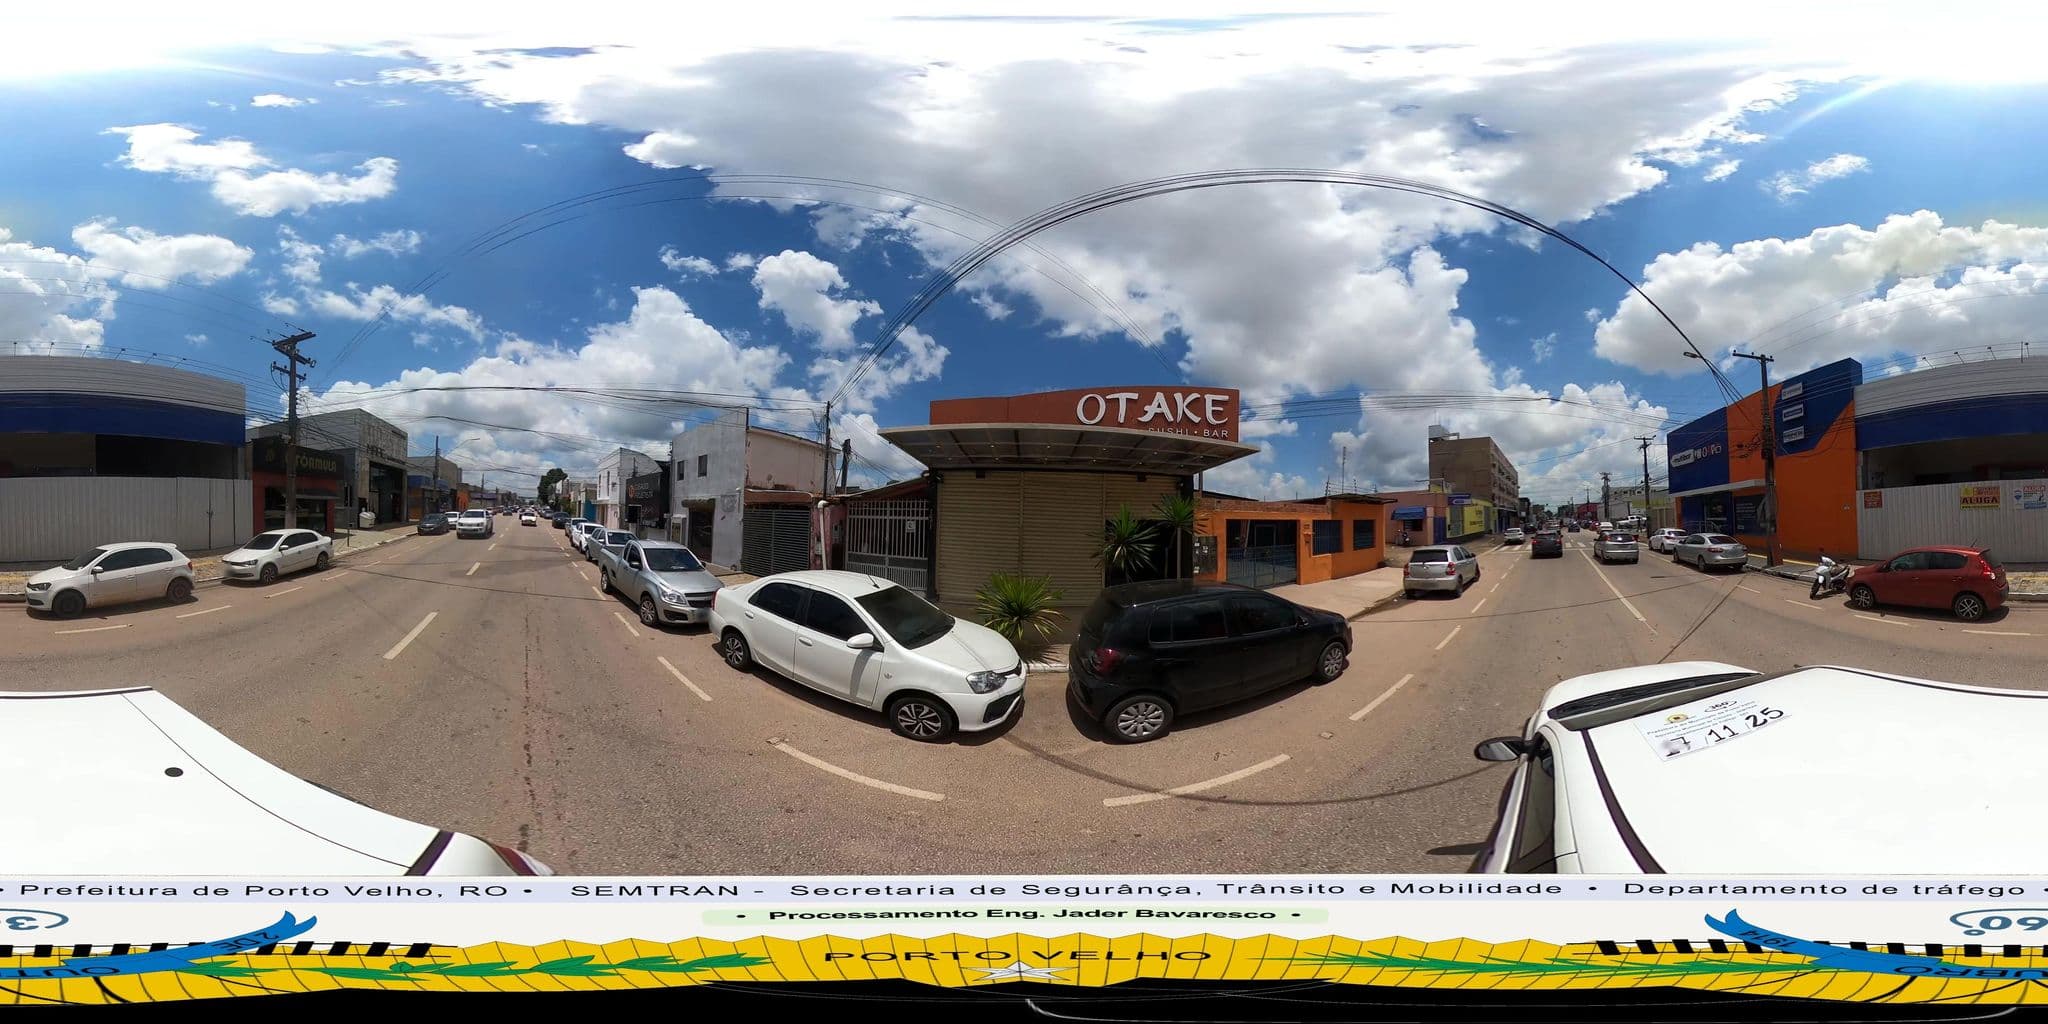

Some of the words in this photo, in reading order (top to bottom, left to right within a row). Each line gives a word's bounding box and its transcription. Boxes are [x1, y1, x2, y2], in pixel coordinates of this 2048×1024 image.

[1076, 392, 1230, 425] OTAKE
[1203, 429, 1229, 438] BAR
[1962, 496, 1998, 504] ALUGA
